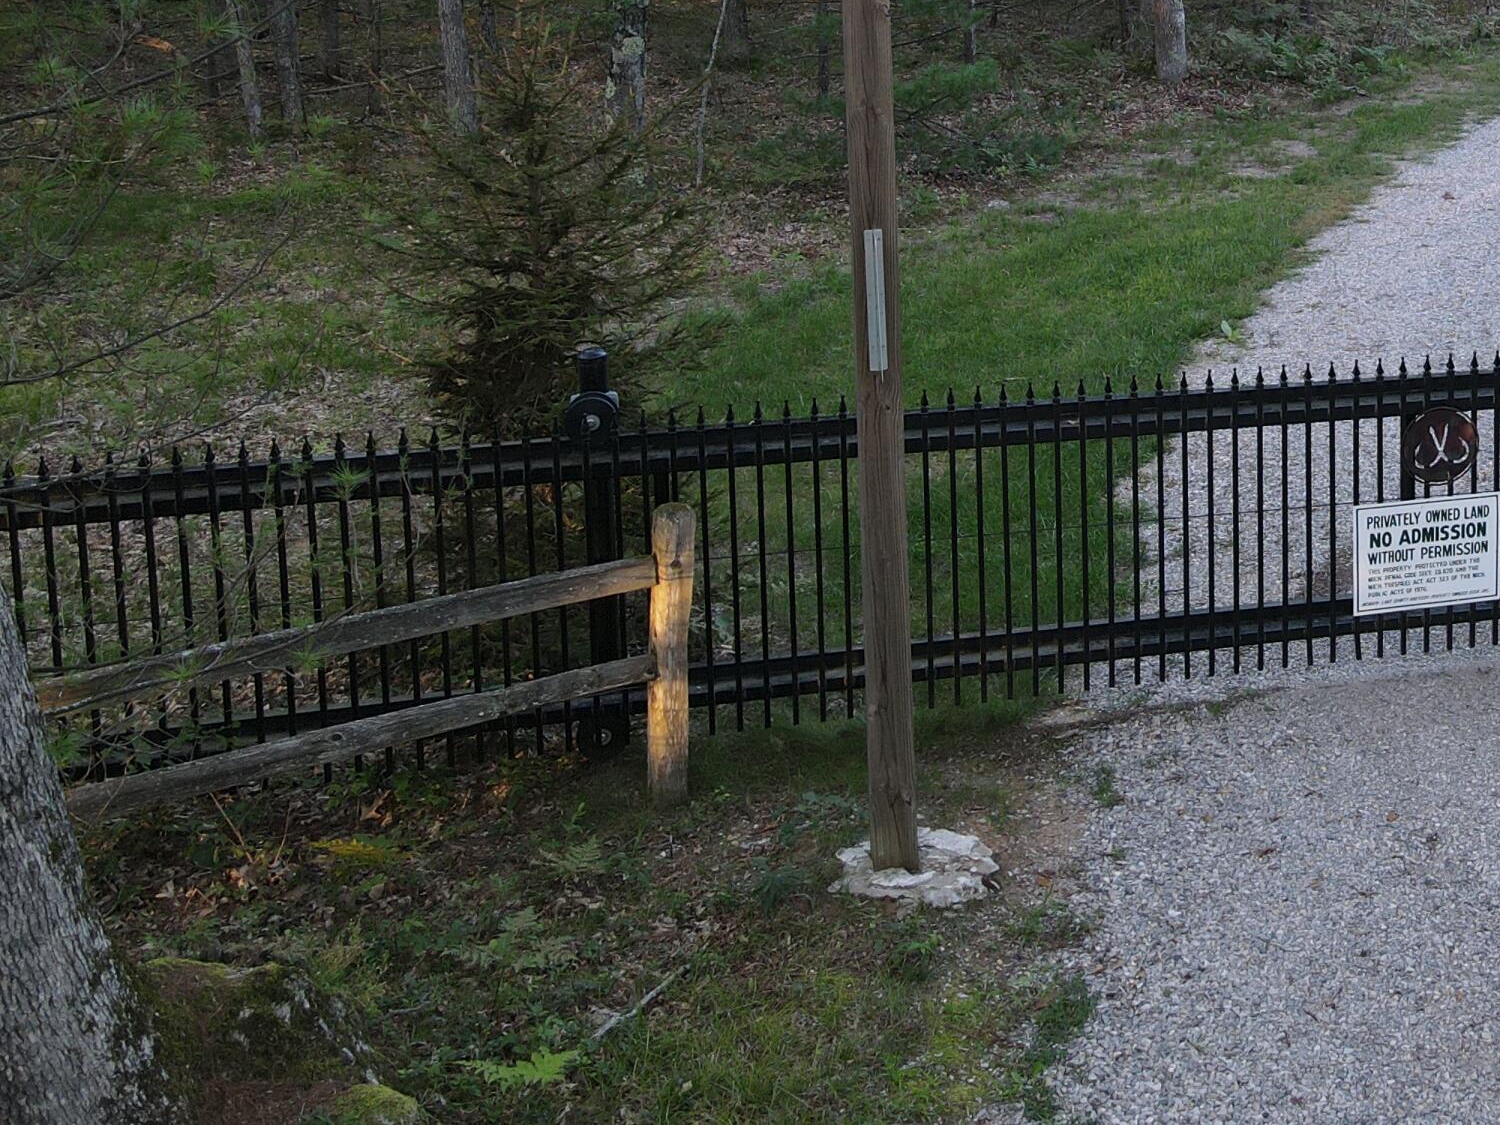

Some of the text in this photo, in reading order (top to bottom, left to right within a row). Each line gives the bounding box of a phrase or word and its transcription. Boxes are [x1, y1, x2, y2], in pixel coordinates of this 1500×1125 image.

[1366, 504, 1490, 530] PRIVATELY OWNED LAND
[1369, 521, 1487, 549] NO ADMISSION
[1367, 540, 1489, 565] WITHOUT PERMISSION
